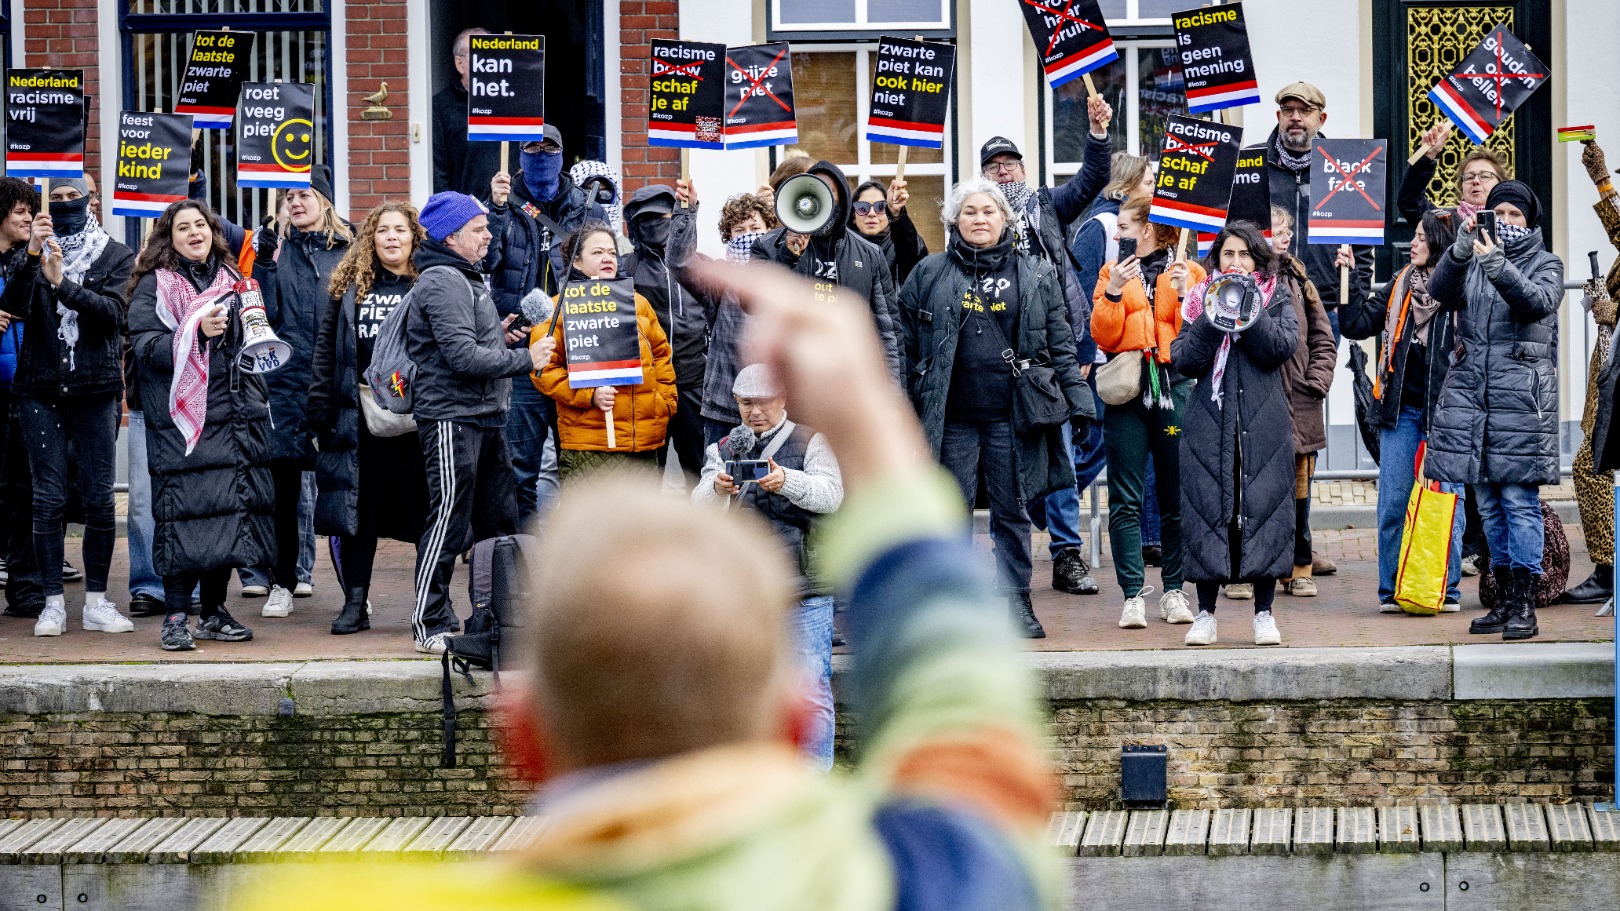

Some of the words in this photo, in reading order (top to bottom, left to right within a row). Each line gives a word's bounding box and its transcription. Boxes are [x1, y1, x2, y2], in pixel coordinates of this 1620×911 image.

[1044, 4, 1080, 28] haar
[1176, 9, 1237, 29] racisme
[1048, 19, 1091, 48] pruik
[1178, 32, 1192, 46] is
[196, 35, 215, 47] tot
[218, 35, 235, 48] de
[472, 38, 539, 50] Nederland
[192, 49, 235, 63] laatste
[653, 45, 715, 60] racisme
[880, 43, 935, 60] zwarte
[1045, 52, 1064, 63] #kozp
[1182, 46, 1221, 64] geen
[472, 54, 512, 73] kan
[653, 60, 701, 76] bouw
[878, 59, 910, 74] piet
[915, 62, 943, 77] kan
[1184, 59, 1244, 78] mening
[1482, 36, 1536, 88] gouden
[188, 66, 232, 78] zwarte
[732, 64, 778, 84] grijze
[10, 76, 78, 88] Nederland
[183, 80, 209, 94] piet
[472, 77, 515, 97] het.
[652, 79, 698, 94] schaf
[876, 76, 907, 90] ook
[912, 78, 943, 93] hier
[1188, 80, 1207, 88] #kozp
[1464, 64, 1506, 108] bellen
[10, 91, 74, 104] racisme
[245, 86, 280, 100] roet
[740, 82, 773, 99] piet
[651, 95, 668, 111] je
[672, 97, 689, 111] af
[874, 91, 905, 106] niet
[10, 107, 36, 123] vrij
[122, 114, 153, 126] feest
[245, 106, 285, 120] veeg
[652, 112, 673, 120] #kozp
[873, 109, 894, 117] #kozp
[122, 129, 150, 139] voor
[244, 122, 276, 138] piet
[1168, 121, 1231, 143] racisme
[10, 143, 30, 151] #kozp
[120, 141, 172, 160] ieder
[1166, 136, 1214, 157] bouw
[118, 161, 162, 180] kind
[1162, 156, 1209, 175] schaf
[1324, 159, 1371, 173] black
[1157, 171, 1174, 188] je
[1178, 176, 1197, 190] af
[1328, 177, 1366, 191] face
[1157, 189, 1178, 198] #kozp
[564, 285, 586, 298] tot
[591, 283, 610, 296] de
[565, 300, 616, 314] laatste
[567, 316, 619, 331] zwarte
[569, 334, 599, 351] piet
